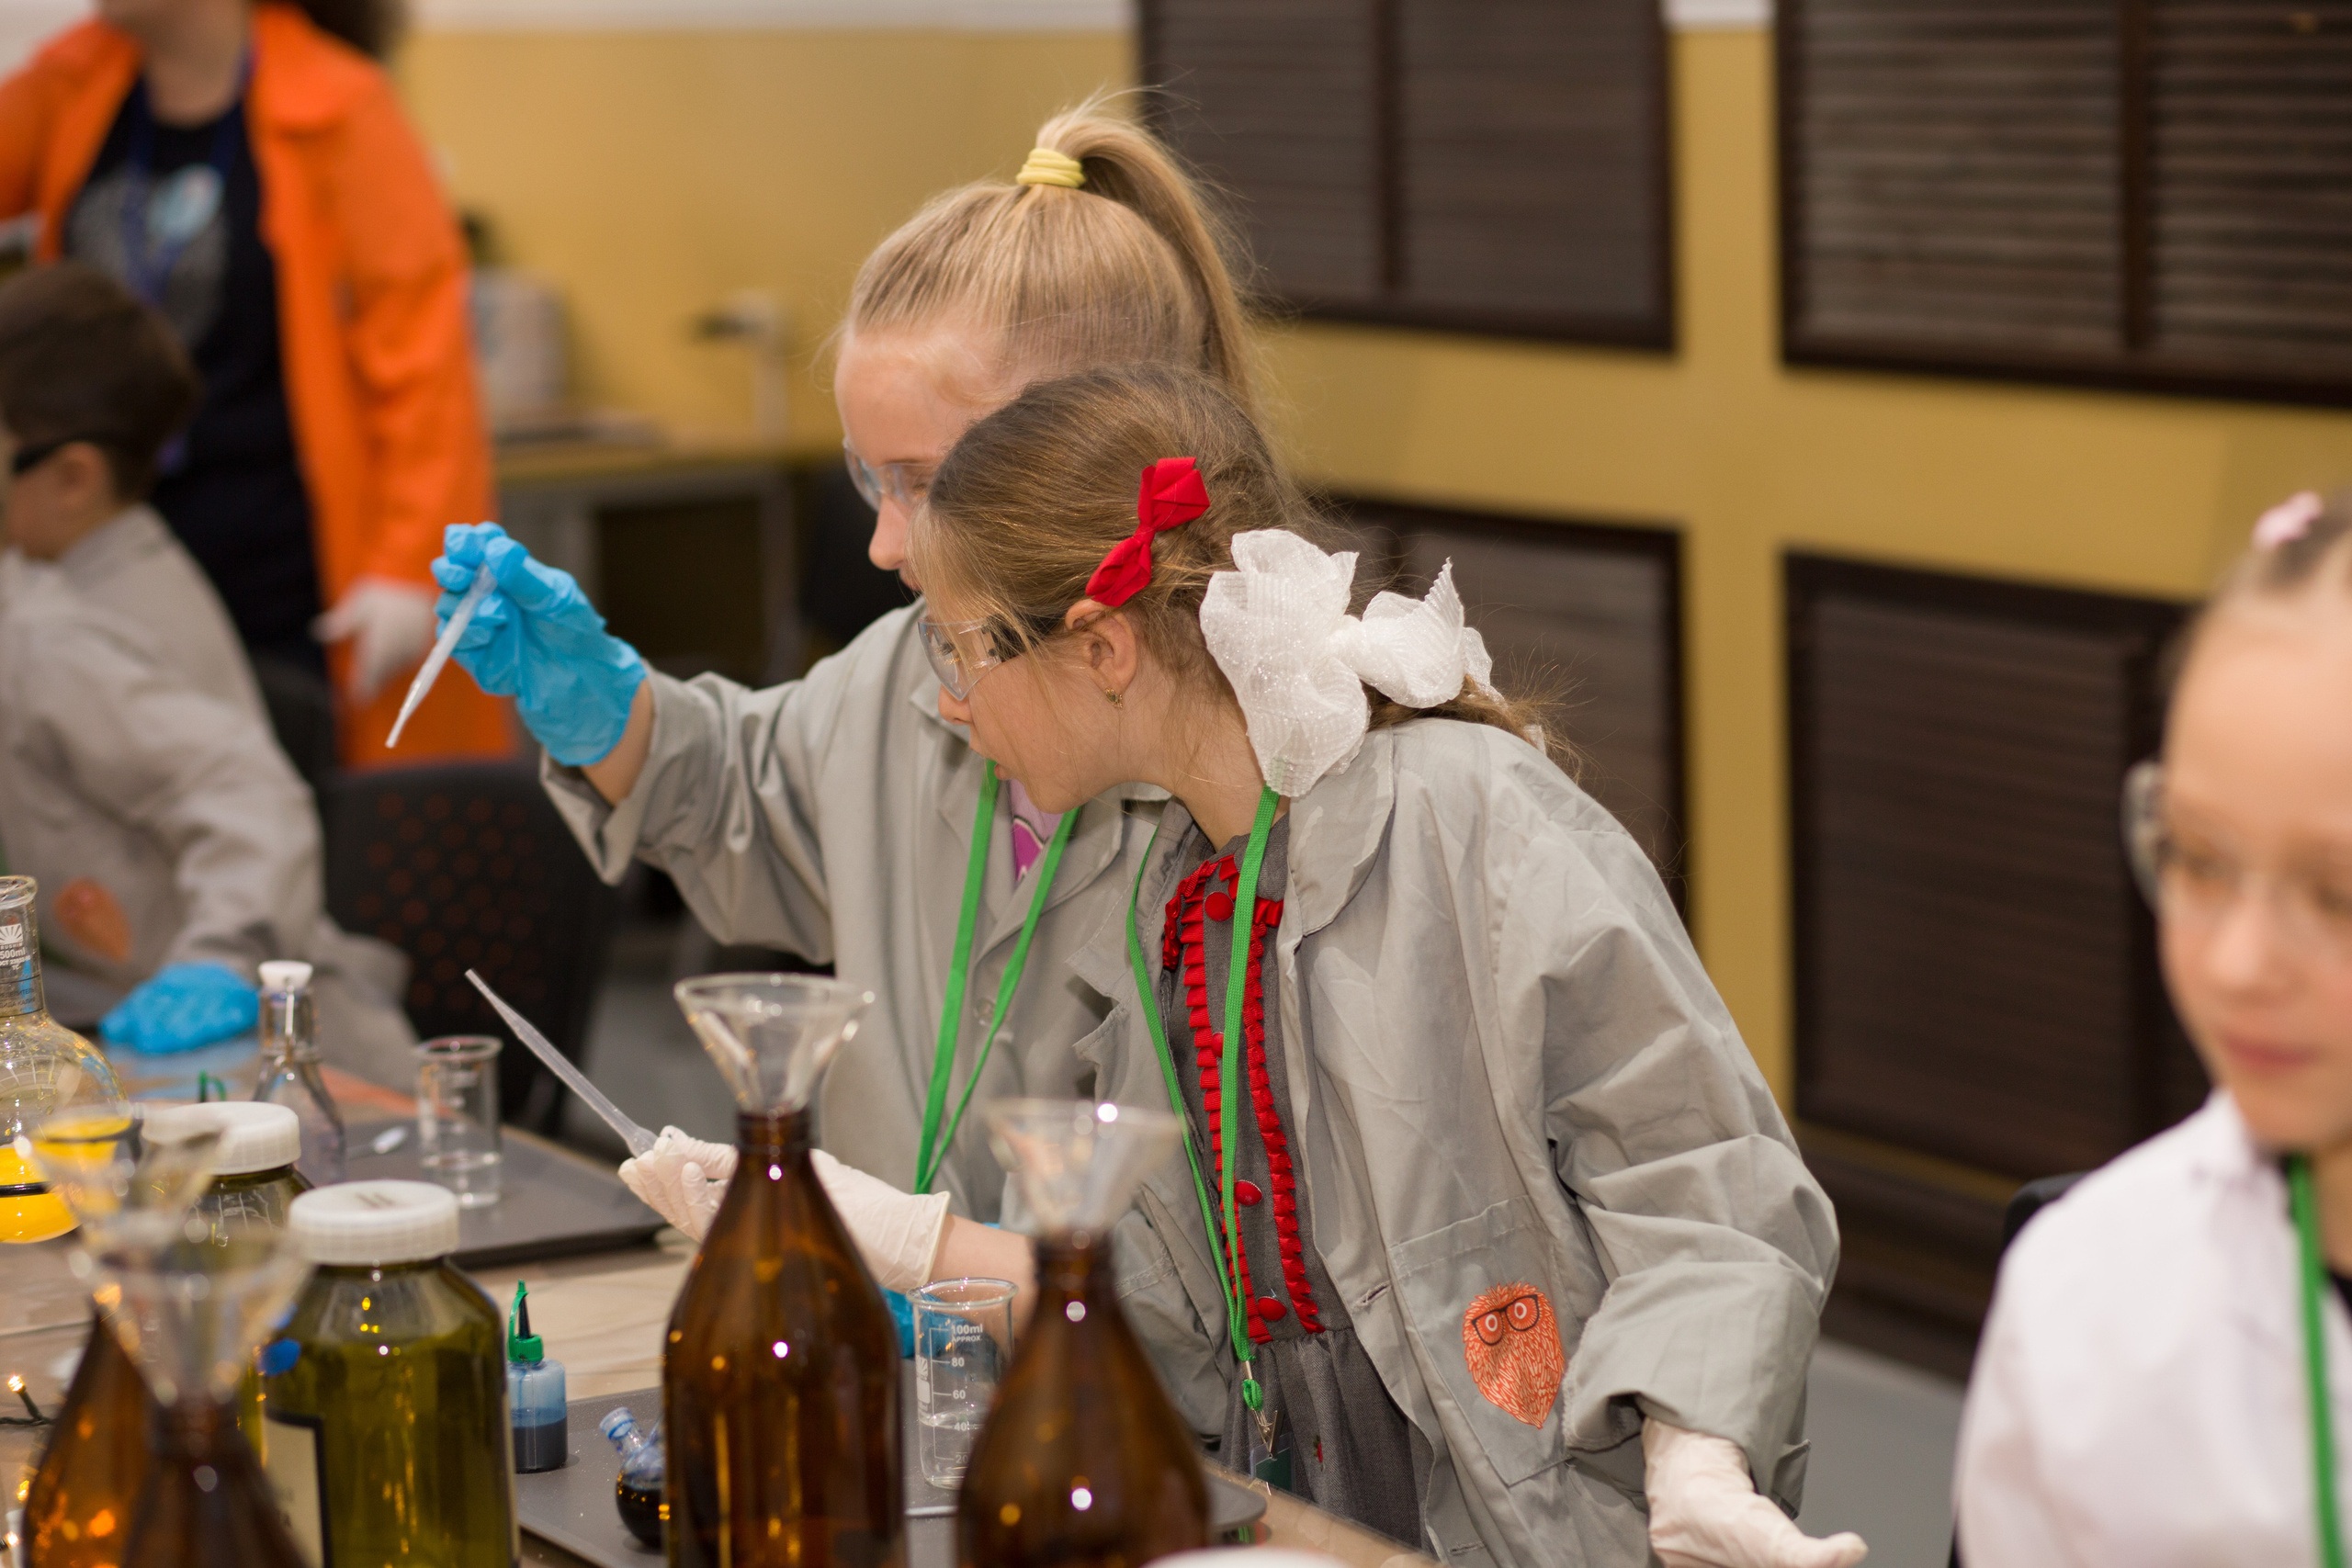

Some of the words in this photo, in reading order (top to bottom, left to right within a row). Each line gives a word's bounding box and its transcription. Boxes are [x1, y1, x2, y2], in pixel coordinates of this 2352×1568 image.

[0, 947, 26, 960] 500ml
[951, 1324, 983, 1335] 100ml
[951, 1357, 965, 1368] 80
[953, 1389, 966, 1400] 60
[954, 1421, 967, 1432] 40
[956, 1454, 968, 1464] 20
